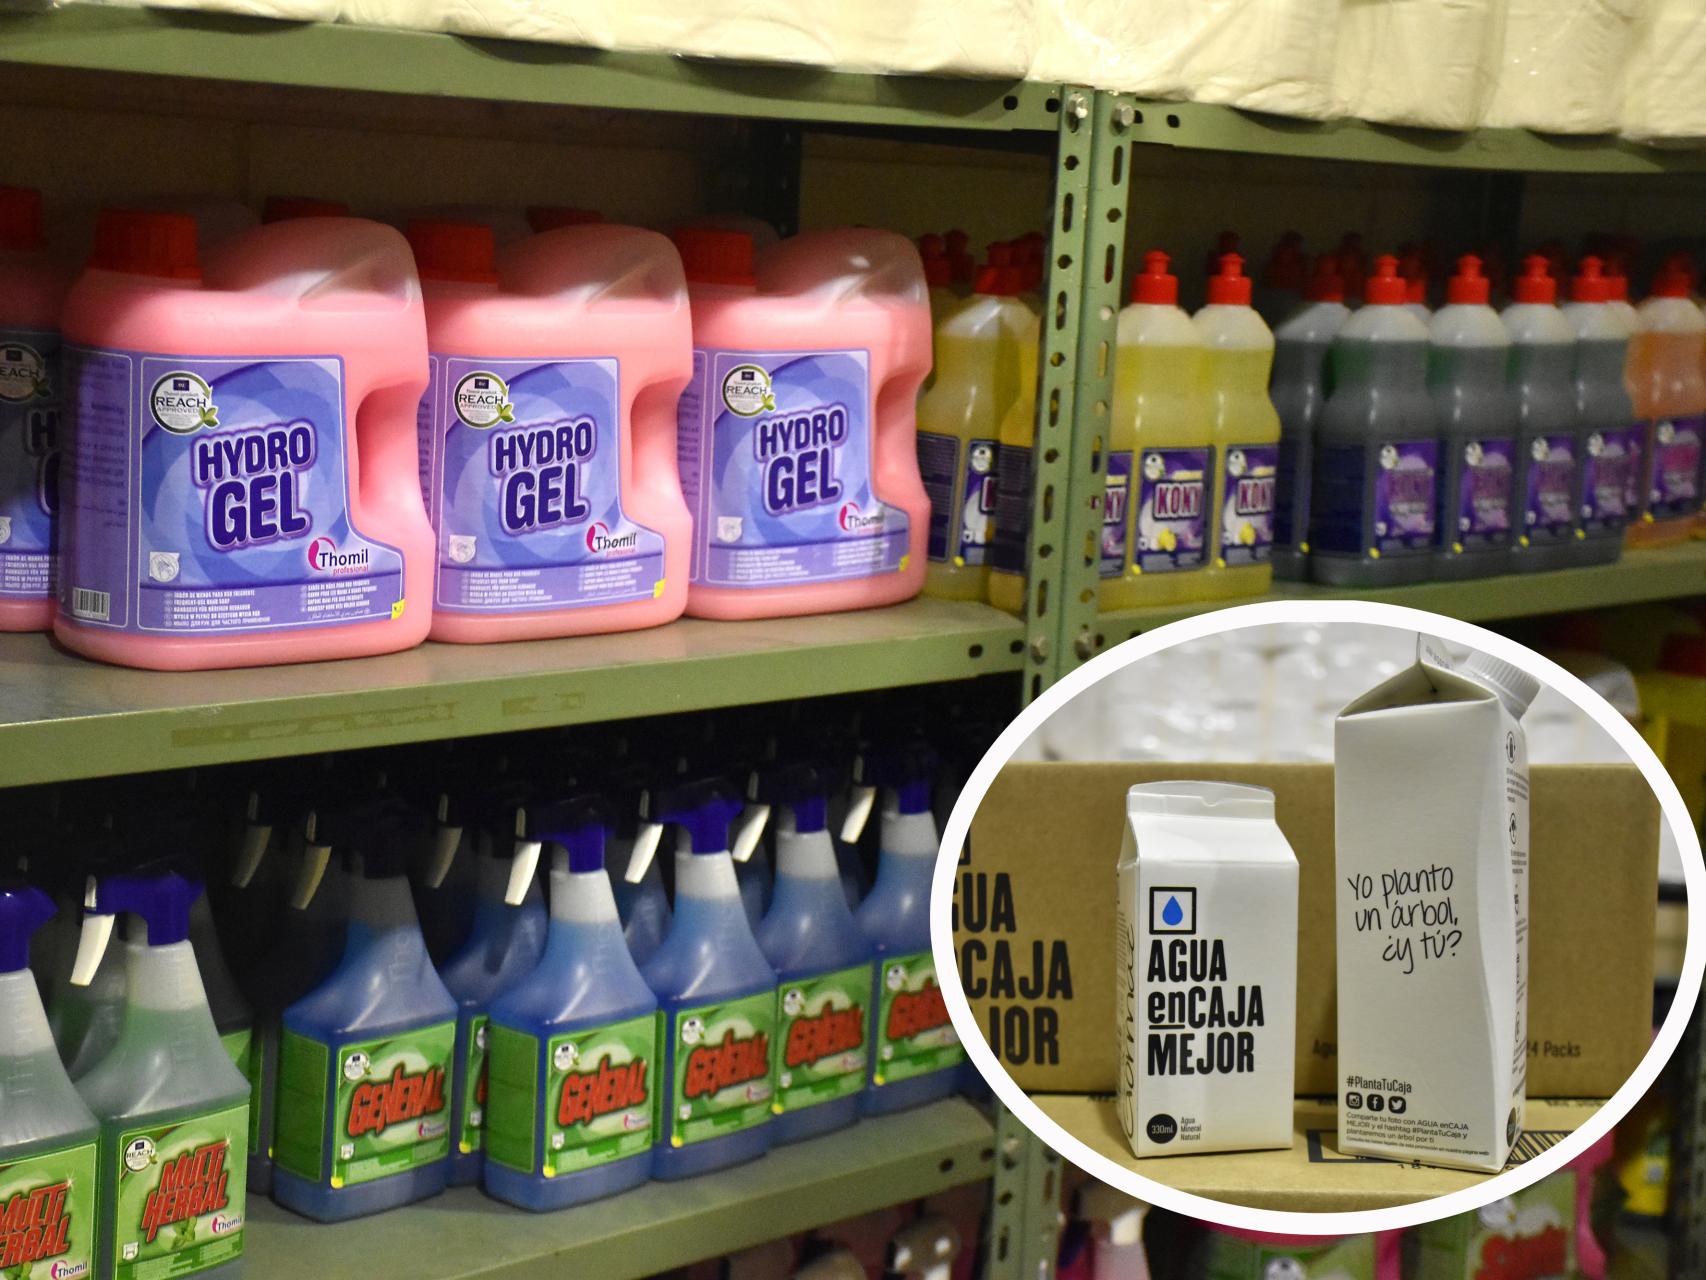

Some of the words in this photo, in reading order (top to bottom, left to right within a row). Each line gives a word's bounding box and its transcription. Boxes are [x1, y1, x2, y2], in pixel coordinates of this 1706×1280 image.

[156, 396, 206, 407] REACH
[460, 394, 503, 404] REACH
[727, 386, 767, 395] REACH
[495, 421, 592, 472] HYDRO
[759, 409, 844, 457] HYDRO
[198, 426, 312, 483] HYDRO
[768, 447, 839, 511] GEL
[211, 470, 308, 547] GEL
[504, 462, 587, 531] GEL
[595, 532, 637, 550] Thomil
[319, 548, 368, 567] Thomil
[1348, 873, 1373, 901] Yo
[1381, 864, 1454, 909] planto
[1355, 907, 1381, 932] un
[1147, 939, 1227, 982] AGUA
[1420, 929, 1463, 961] tú?
[1147, 985, 1264, 1029] enCAJA
[1147, 1031, 1254, 1076] MEJOR
[1544, 1039, 1581, 1058] Packs
[347, 1063, 446, 1138] GENERAL
[558, 1054, 647, 1127] GENERAL
[1346, 1074, 1412, 1096] #PlantaTuCaja
[1151, 1124, 1174, 1135] 330ml
[1347, 1111, 1379, 1122] Comparte
[1388, 1116, 1402, 1124] foto
[1417, 1119, 1439, 1128] AGUA
[1440, 1122, 1469, 1131] enCAJA
[1347, 1119, 1370, 1128] MEJOR
[1415, 1136, 1428, 1144] por
[141, 1171, 228, 1243] HERBAL
[57, 1260, 88, 1278] Thomil
